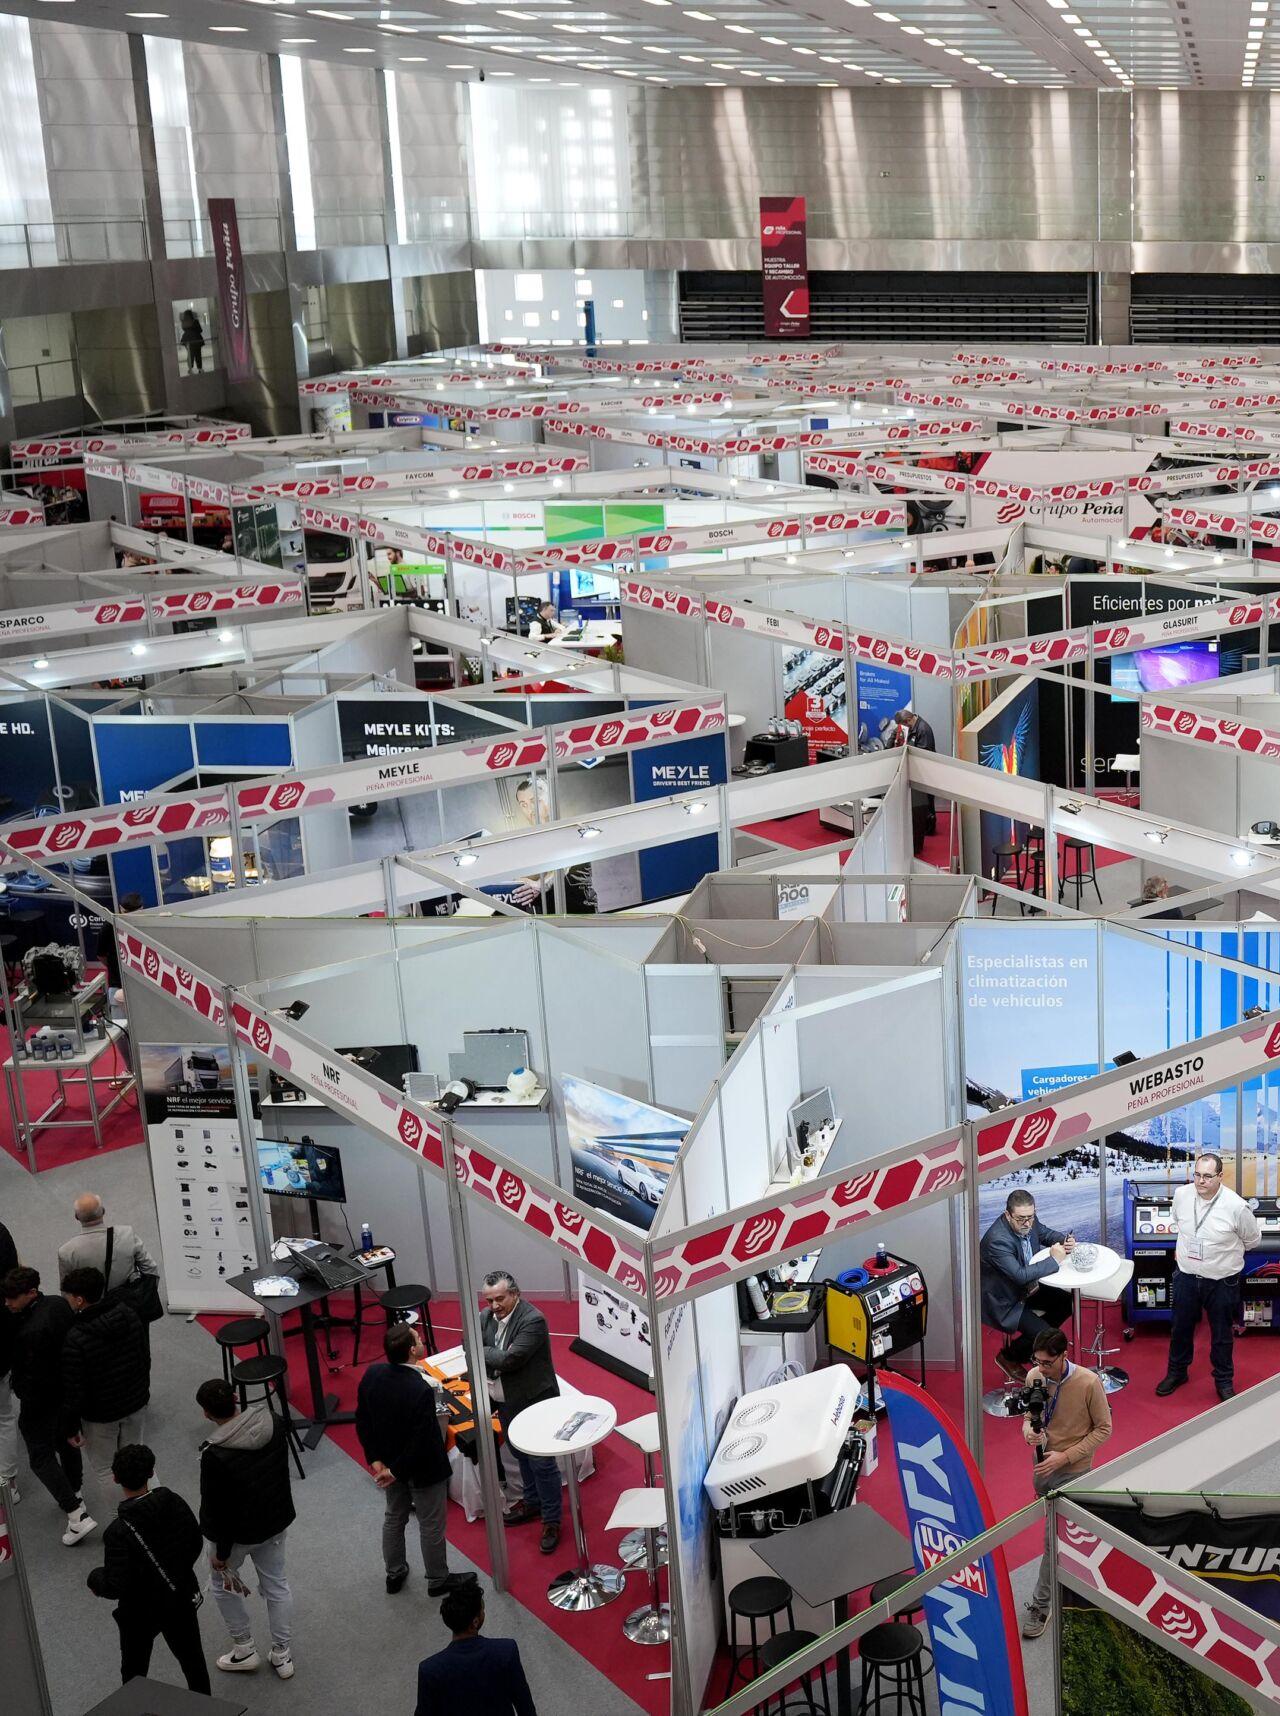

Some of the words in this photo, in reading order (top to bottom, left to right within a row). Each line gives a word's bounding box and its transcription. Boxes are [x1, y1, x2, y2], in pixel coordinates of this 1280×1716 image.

[222, 222, 234, 270] Peña
[229, 274, 240, 329] Grupo
[405, 472, 434, 480] FAYCOM
[899, 471, 932, 482] PRESUPUESTOS
[1166, 471, 1203, 482] PRESUPUESTOS
[1029, 503, 1078, 521] Grupo
[1082, 501, 1124, 515] Peña
[708, 529, 734, 539] BOSCH
[1092, 595, 1164, 611] Eficientes
[1168, 599, 1189, 614] por
[0, 616, 45, 629] SPARCO
[766, 617, 780, 627] FEBI
[1162, 616, 1198, 629] GLASURIT
[810, 696, 822, 708] 3
[11, 723, 35, 734] HD.
[364, 723, 412, 737] MEYLE
[379, 763, 420, 780] MEYLE
[652, 765, 710, 780] MEYLE
[387, 774, 434, 789] PROFESIONAL
[967, 955, 1065, 973] Especialistas
[1070, 957, 1089, 969] en
[967, 974, 1068, 989] climatización
[968, 993, 987, 1008] de
[992, 993, 1064, 1008] vehículos
[322, 1061, 341, 1085] NRF
[1129, 1056, 1205, 1096] WEBASTO
[166, 1096, 181, 1104] NRF
[188, 1096, 207, 1105] mejor
[208, 1097, 232, 1105] servicio
[324, 1081, 360, 1111] PROFESIONAL
[1127, 1093, 1149, 1111] PEÑA
[1150, 1075, 1205, 1102] PROFESIONAL
